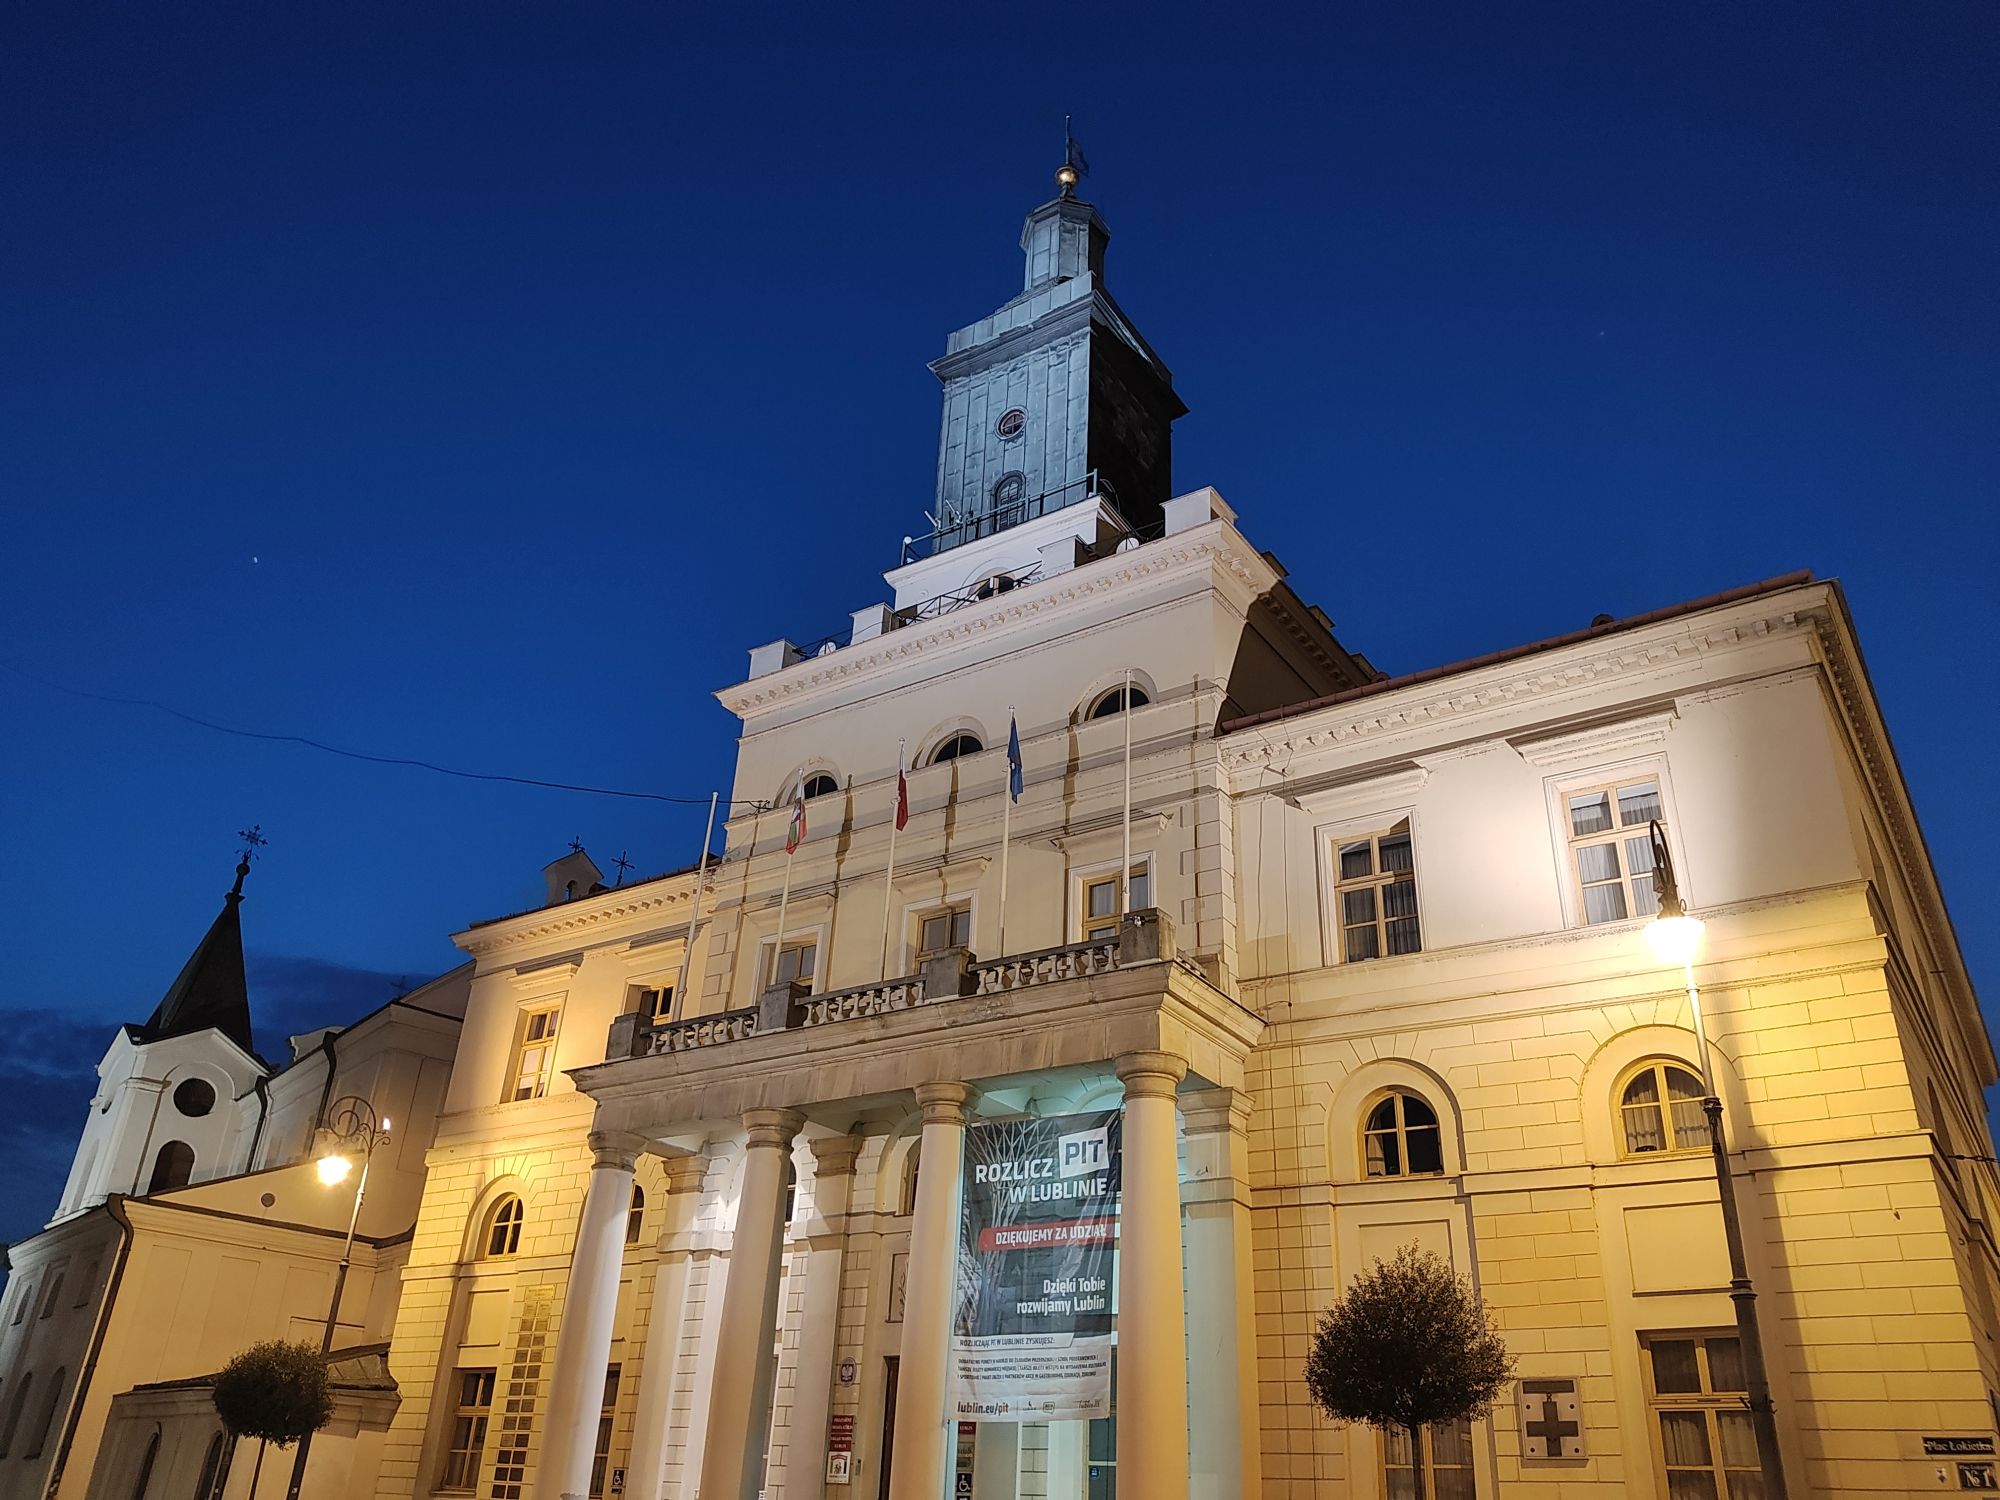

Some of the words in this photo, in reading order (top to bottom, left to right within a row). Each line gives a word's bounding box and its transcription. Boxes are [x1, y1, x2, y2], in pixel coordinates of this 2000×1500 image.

[1065, 1138, 1103, 1166] PIT
[975, 1158, 1054, 1184] ROZLICZ
[1009, 1186, 1028, 1204] W
[1031, 1177, 1108, 1202] LUBLINIE
[995, 1228, 1054, 1247] DZIĘKUJEMY
[1055, 1227, 1069, 1240] ZA
[1070, 1223, 1107, 1239] UDZIAŁ
[1043, 1279, 1076, 1297] Dzięki
[1078, 1276, 1106, 1293] Tobie
[1016, 1299, 1072, 1316] rozwijamy
[1074, 1295, 1105, 1311] Lublin
[1001, 1338, 1025, 1346] LUBLINIE
[957, 1400, 1009, 1416] lublin.eu/pit
[1926, 1441, 1948, 1451] Plac
[1948, 1441, 1993, 1451] Łokietka
[1983, 1469, 1992, 1488] 1
